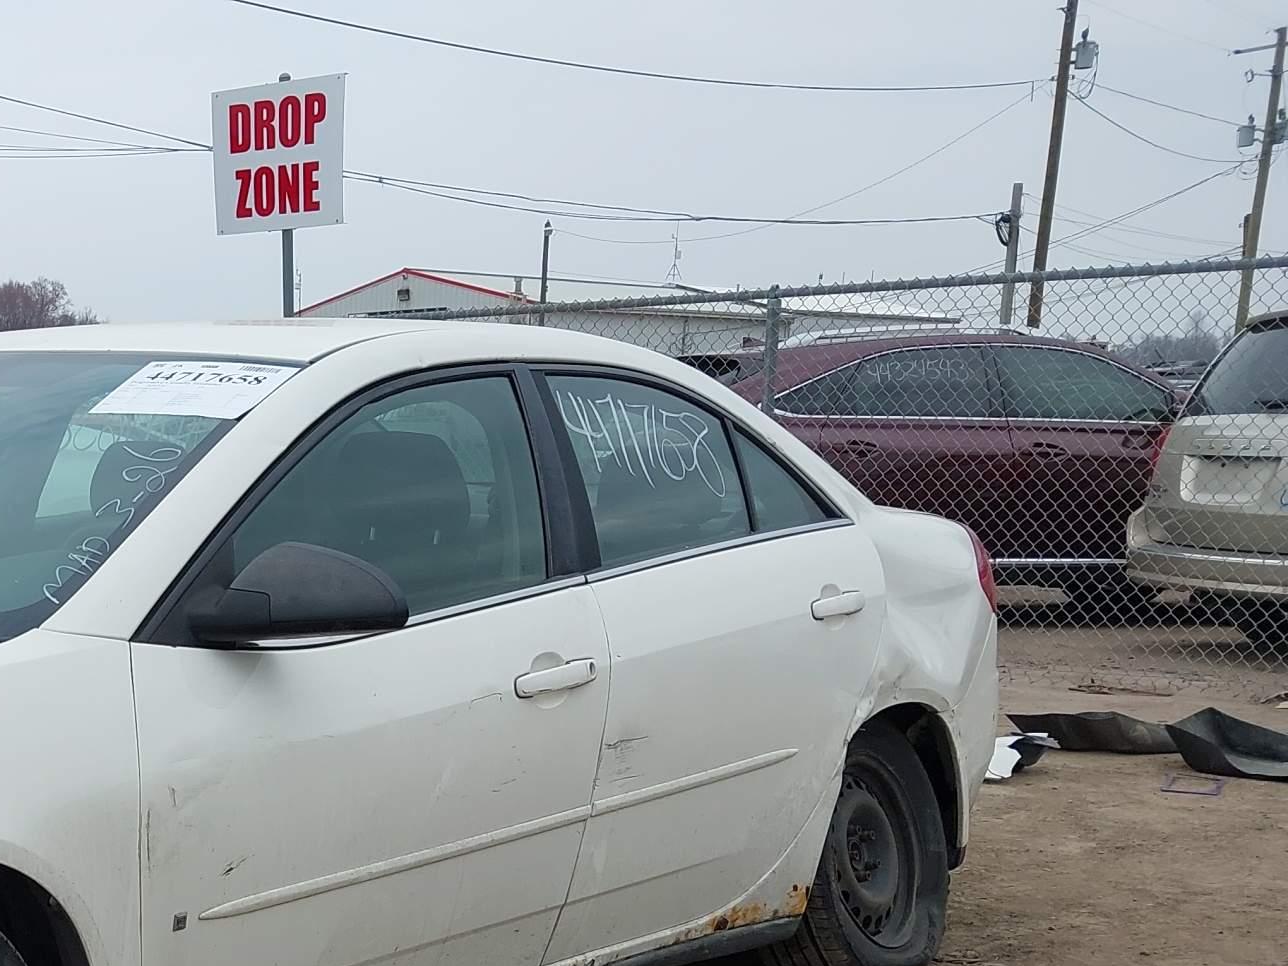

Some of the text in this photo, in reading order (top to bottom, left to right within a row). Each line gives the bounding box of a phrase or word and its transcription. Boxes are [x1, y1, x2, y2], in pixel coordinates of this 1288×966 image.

[228, 92, 327, 154] DROP
[235, 161, 321, 218] ZONE
[146, 370, 268, 386] 44717658
[43, 536, 110, 605] MAD
[95, 447, 182, 529] 3-26
